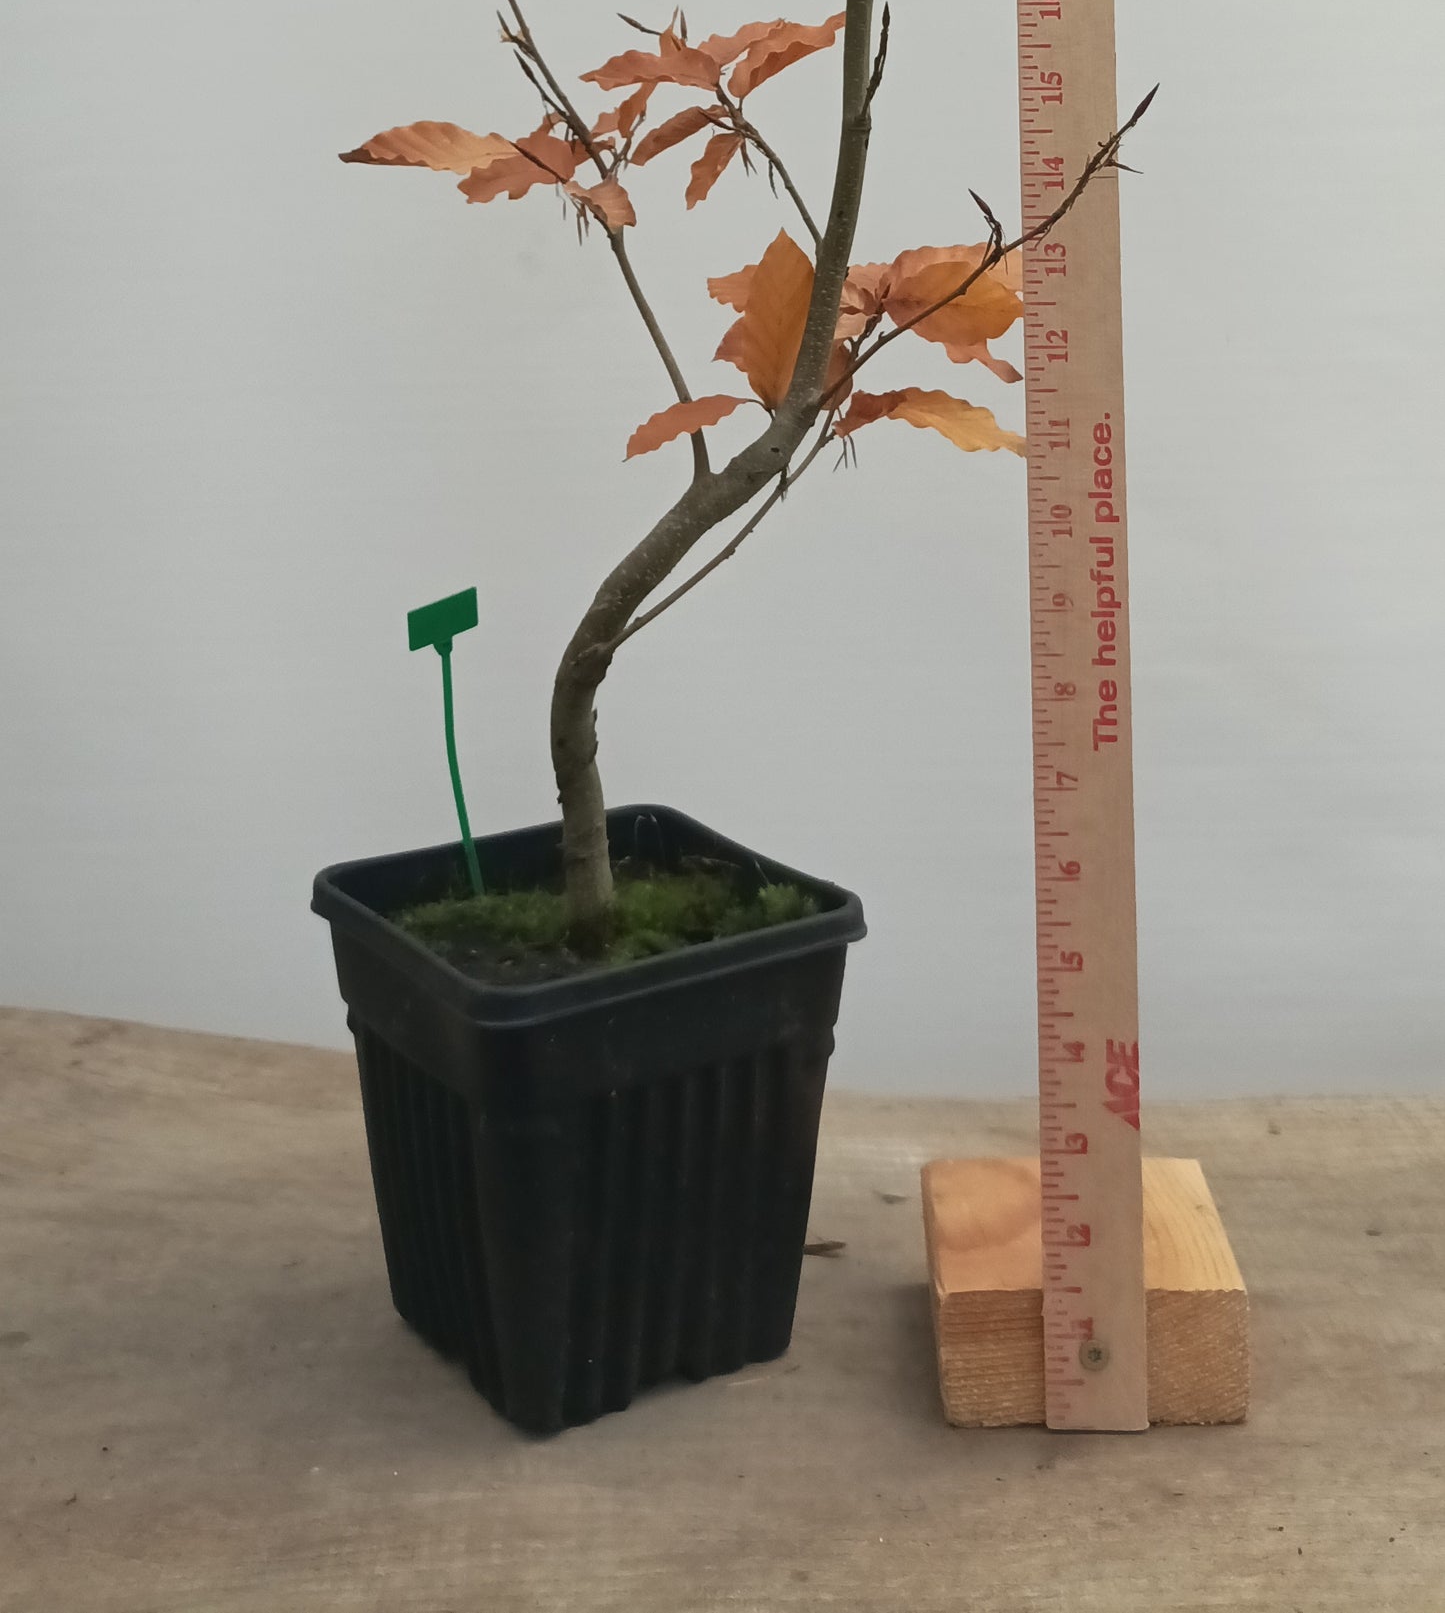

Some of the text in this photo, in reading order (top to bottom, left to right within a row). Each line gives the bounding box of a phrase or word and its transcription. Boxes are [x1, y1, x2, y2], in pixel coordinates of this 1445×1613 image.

[1041, 72, 1063, 105] 15
[1042, 157, 1064, 191] 14
[1044, 243, 1066, 277] 13
[1046, 329, 1068, 363] 12
[1049, 418, 1070, 451] 11
[1051, 504, 1073, 539] 10
[1088, 413, 1121, 751] The helpful place.
[1052, 593, 1074, 607] 9
[1054, 681, 1076, 696] 8
[1057, 771, 1079, 786] 7
[1059, 861, 1081, 875] 6
[1061, 951, 1084, 968] 5
[1063, 1041, 1085, 1060] 4
[1102, 1039, 1140, 1131] ACE
[1065, 1133, 1088, 1152] 3
